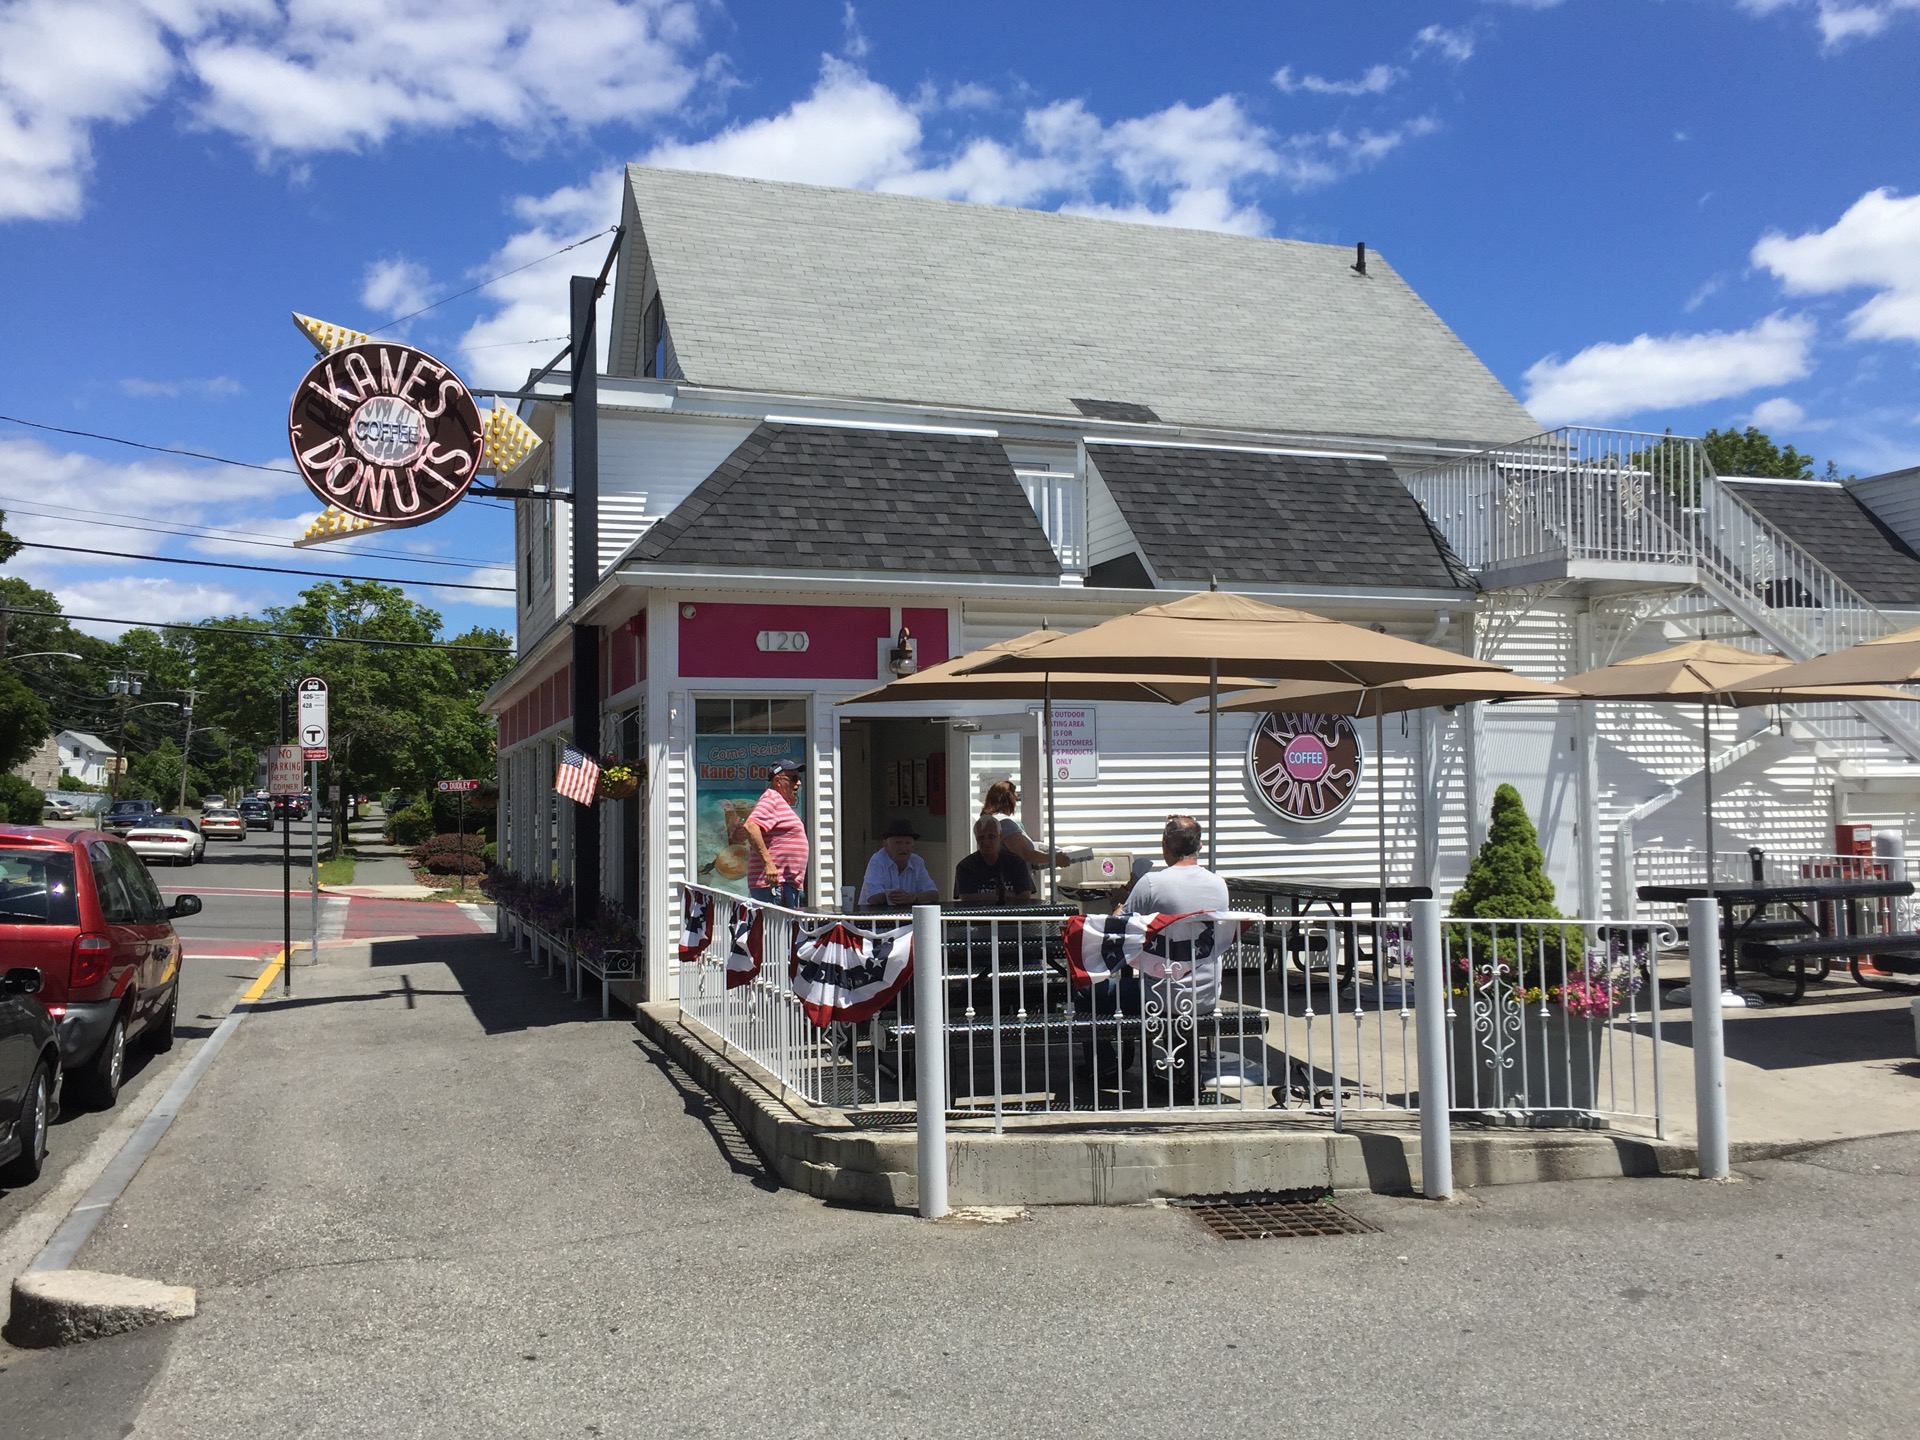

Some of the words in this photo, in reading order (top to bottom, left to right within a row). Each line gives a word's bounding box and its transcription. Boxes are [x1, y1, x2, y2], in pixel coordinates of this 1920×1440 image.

[356, 420, 418, 444] COFFEE
[301, 435, 472, 513] DONUTS
[764, 632, 805, 650] 120
[306, 730, 321, 742] T
[278, 748, 292, 759] NO
[708, 746, 747, 762] Come
[749, 739, 791, 758] Relax!
[1061, 748, 1094, 756] PRODUCTS
[1288, 751, 1323, 764] COFFEE
[271, 761, 301, 771] PARKING
[700, 763, 747, 780] Kane's
[271, 773, 288, 781] HERE
[292, 773, 300, 781] TO
[273, 783, 299, 791] CORNER
[450, 781, 470, 790] DUDLEY
[1258, 762, 1355, 815] DONUTS
